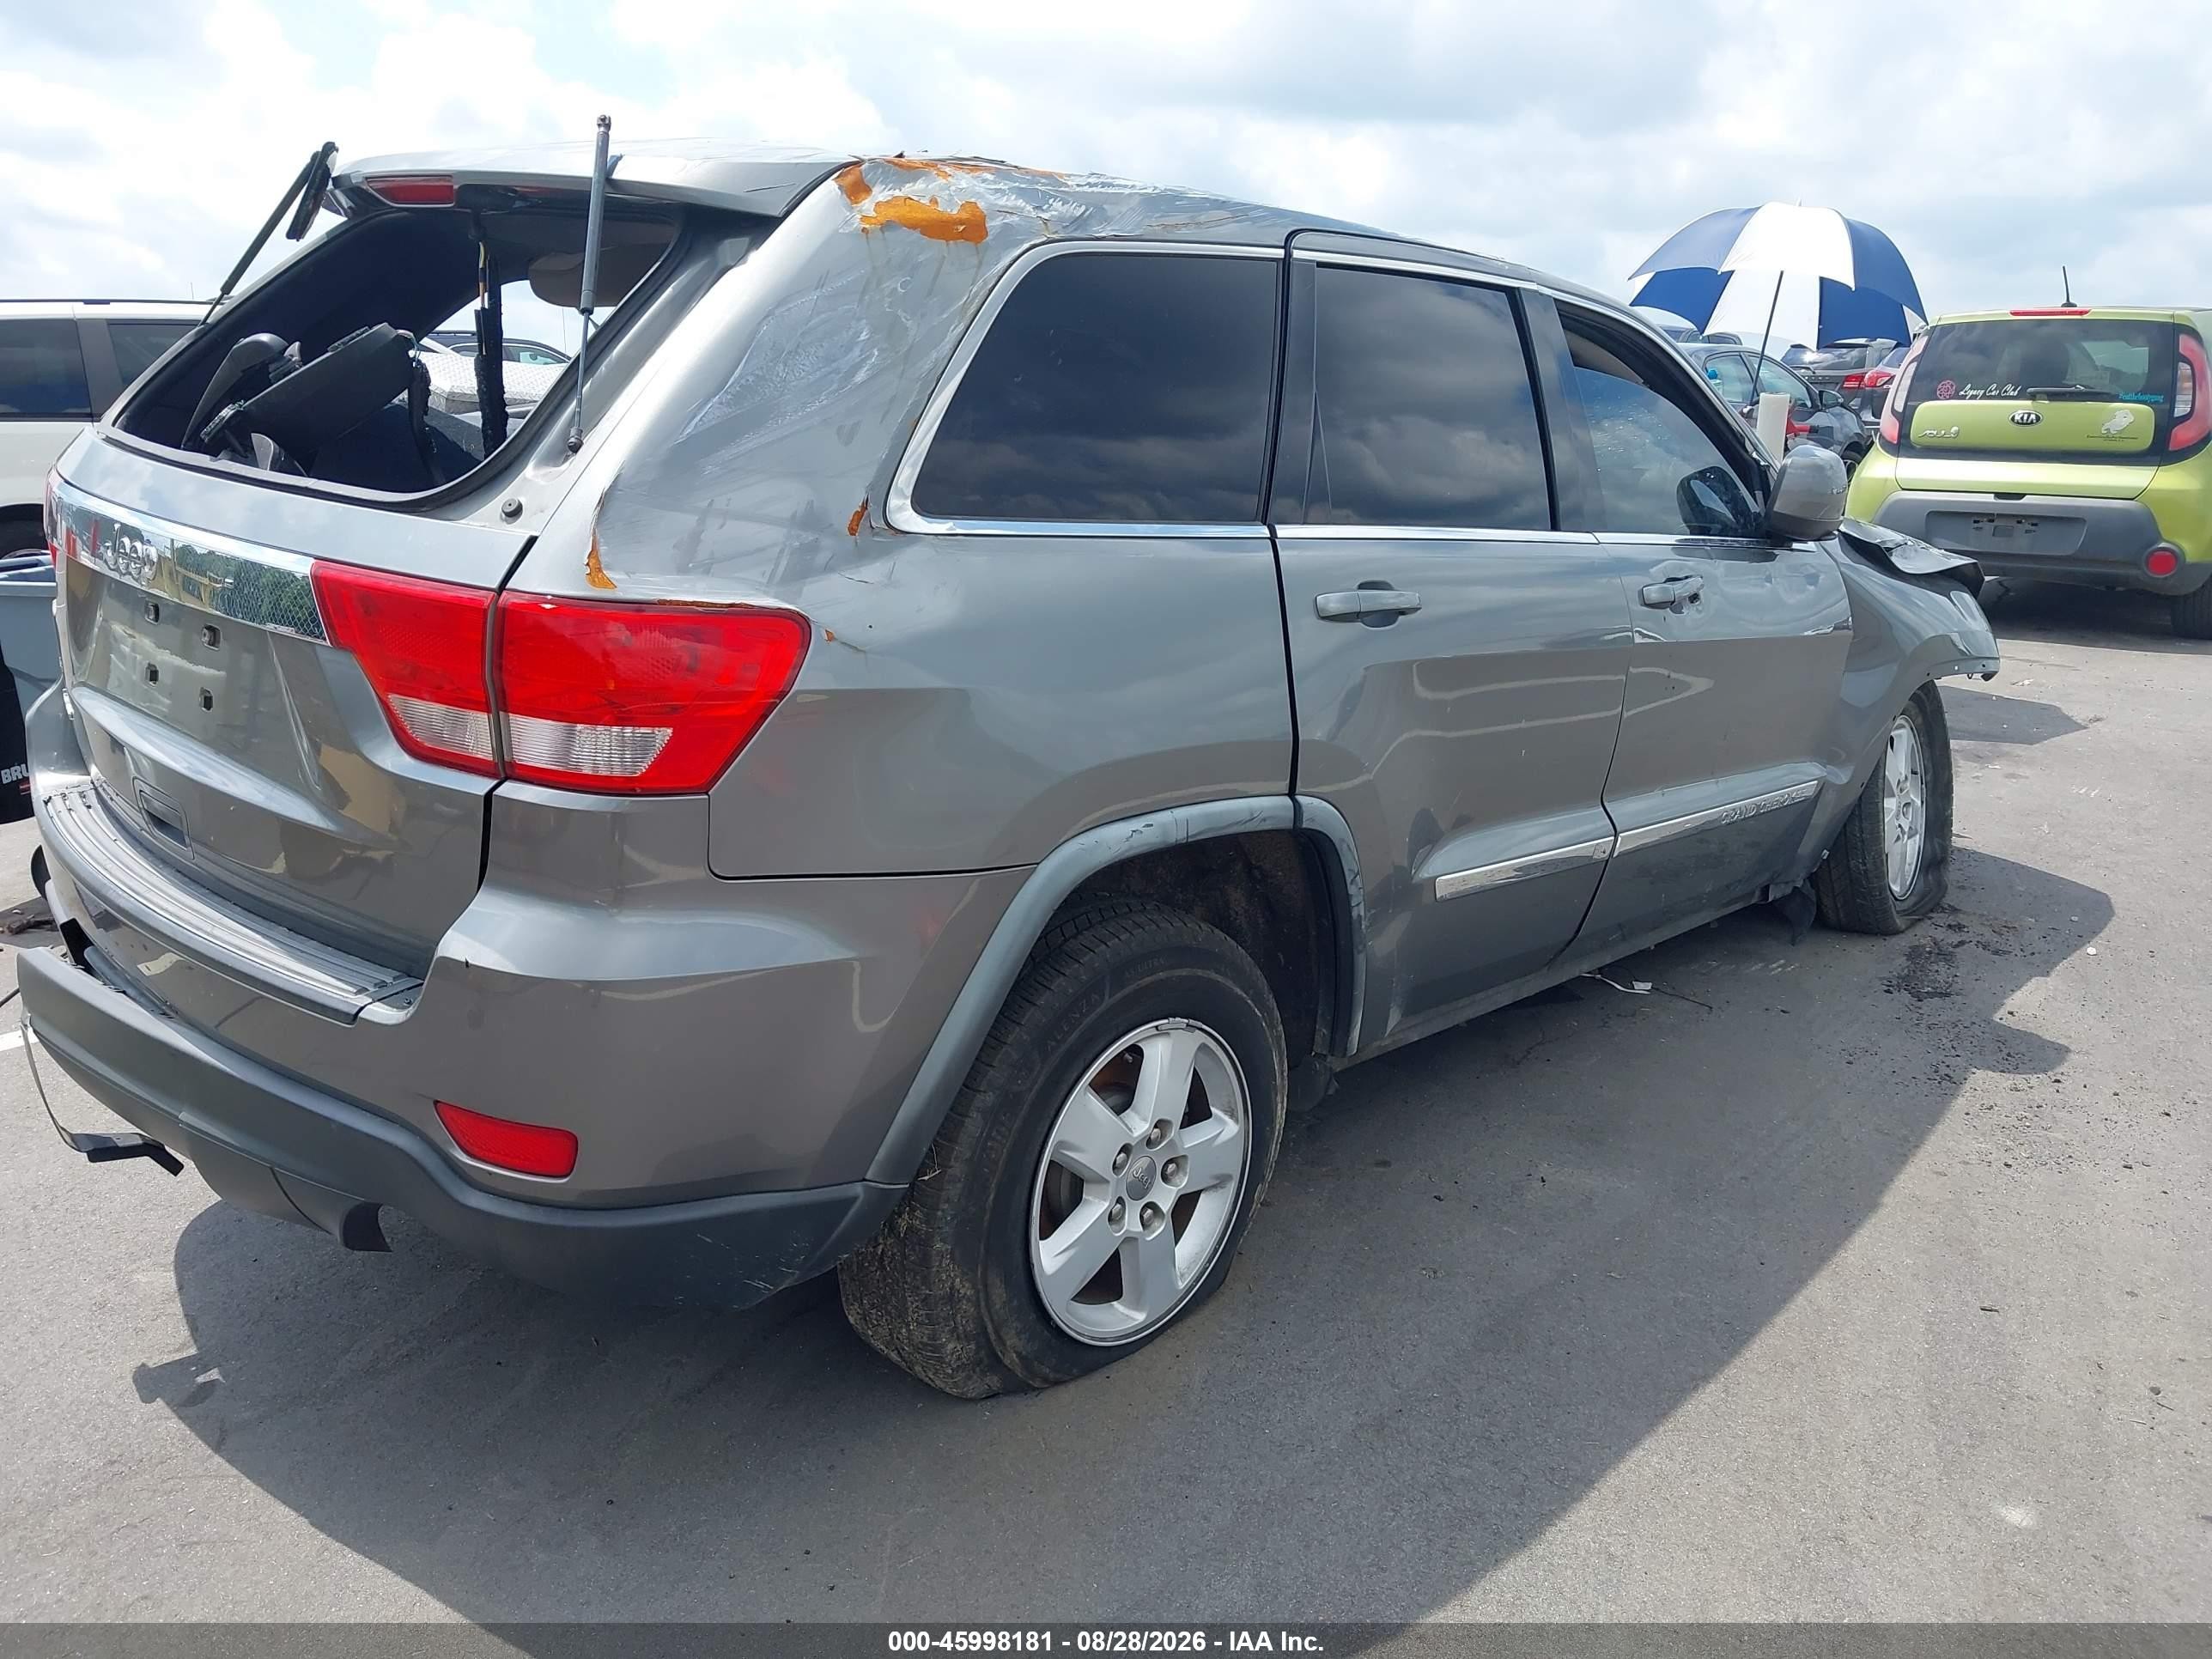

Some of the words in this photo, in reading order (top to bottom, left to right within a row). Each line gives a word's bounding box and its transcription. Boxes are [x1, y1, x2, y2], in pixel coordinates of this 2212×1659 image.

[1959, 383, 1985, 400] Legacy
[1985, 383, 2000, 397] Car
[2001, 383, 2022, 397] Club
[2014, 413, 2037, 423] KIA
[102, 522, 160, 587] Jeep
[1721, 803, 1758, 825] GRAND
